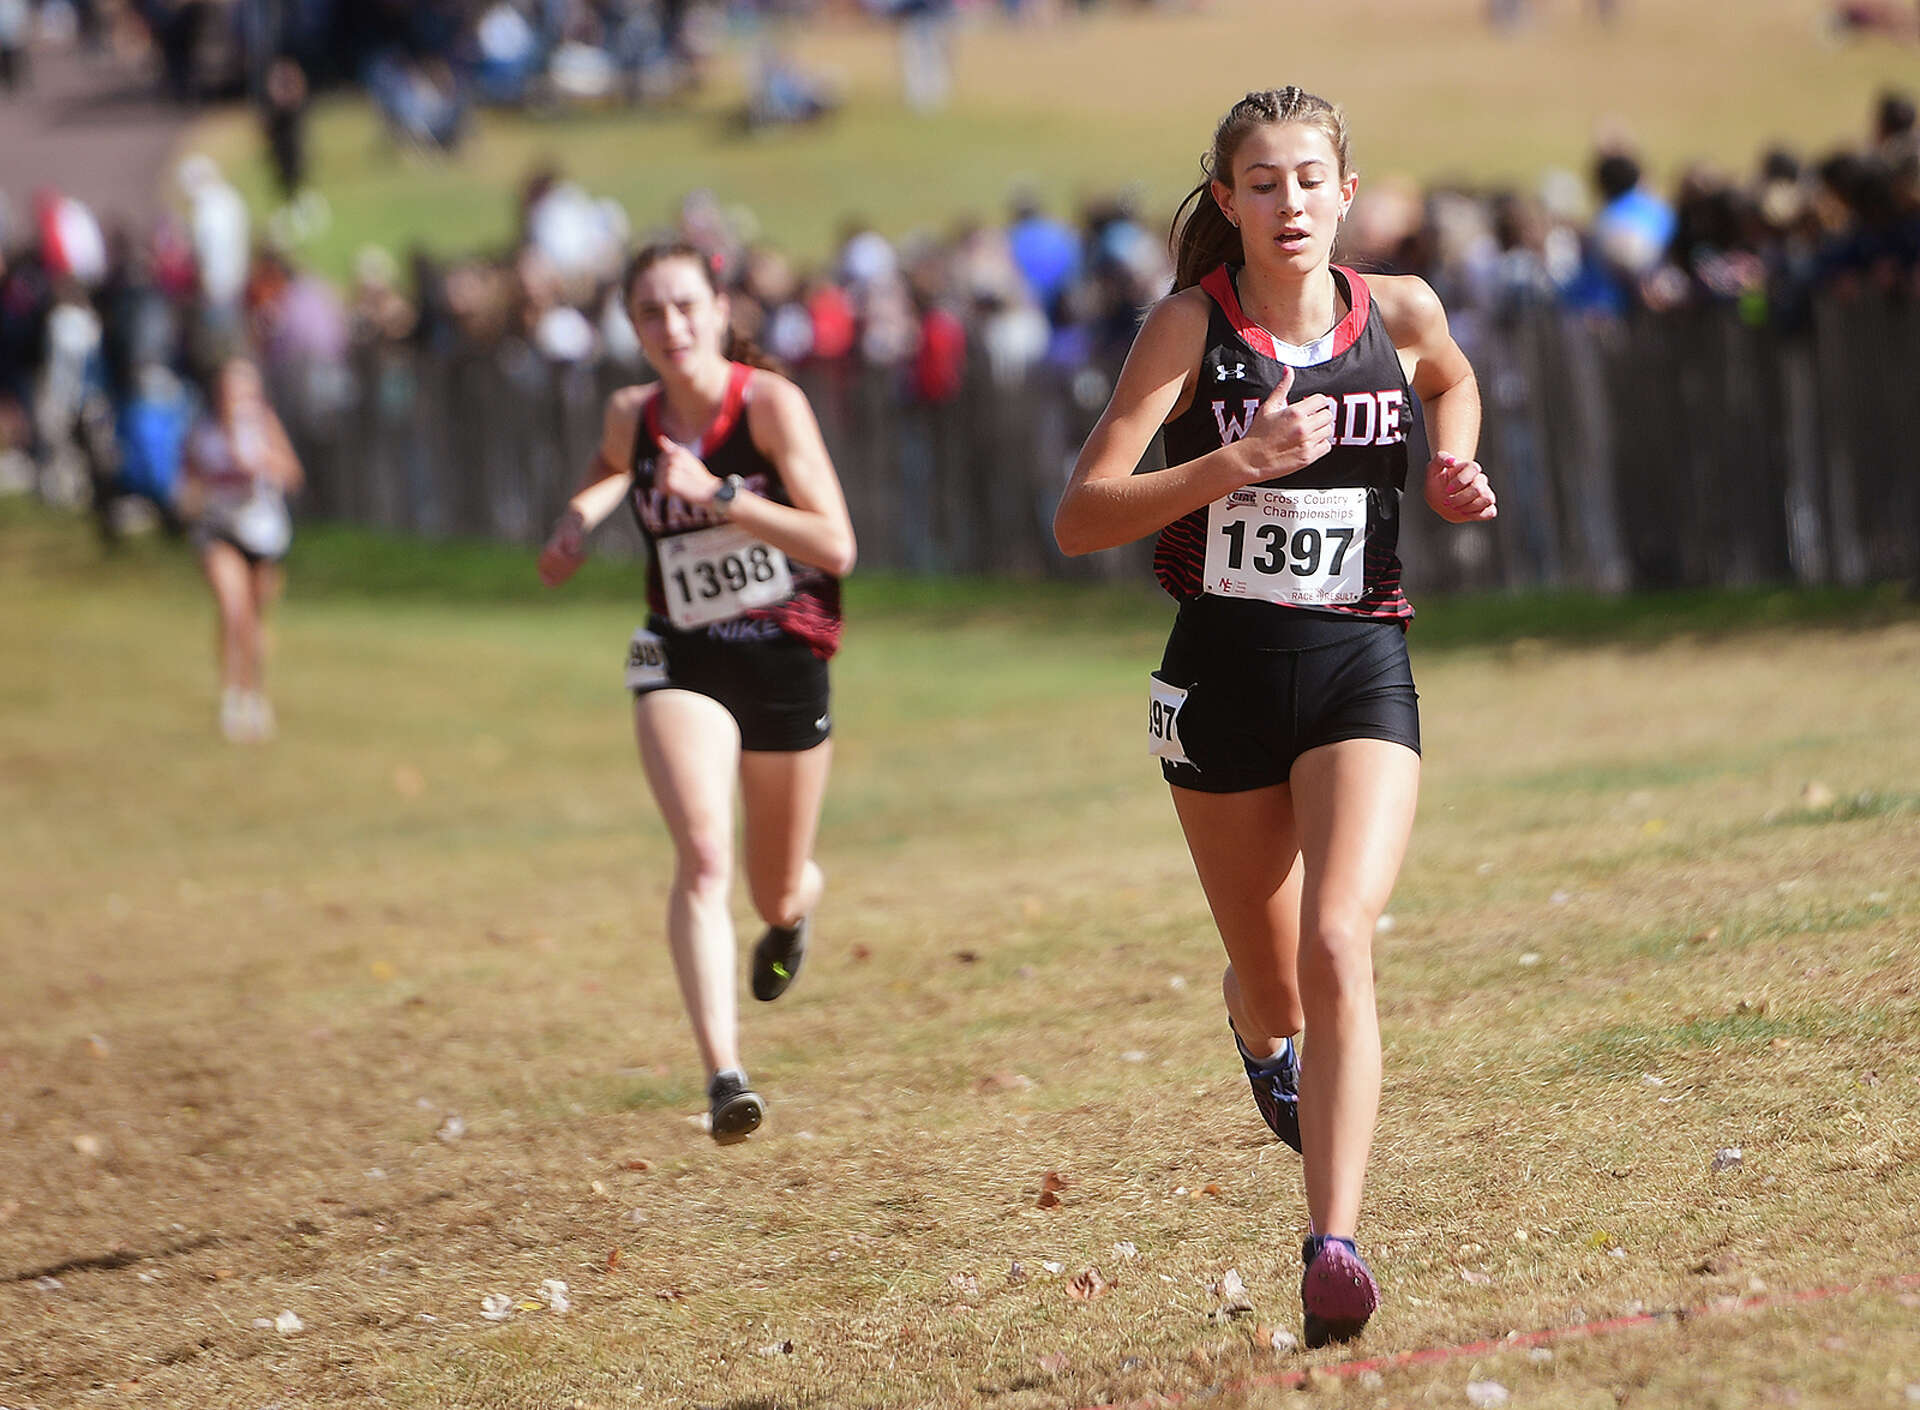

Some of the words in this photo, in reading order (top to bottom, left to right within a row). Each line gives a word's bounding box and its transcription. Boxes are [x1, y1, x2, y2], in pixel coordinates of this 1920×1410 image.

[1212, 390, 1403, 447] WDE
[1263, 506, 1353, 519] Championships
[1264, 493, 1299, 504] Cross
[1304, 494, 1348, 506] Country
[1222, 520, 1354, 577] 1397
[673, 546, 774, 603] 1398
[1292, 592, 1313, 601] RACE
[1325, 592, 1354, 601] RESULT
[708, 621, 780, 640] NIKE
[1149, 697, 1176, 741] 97
